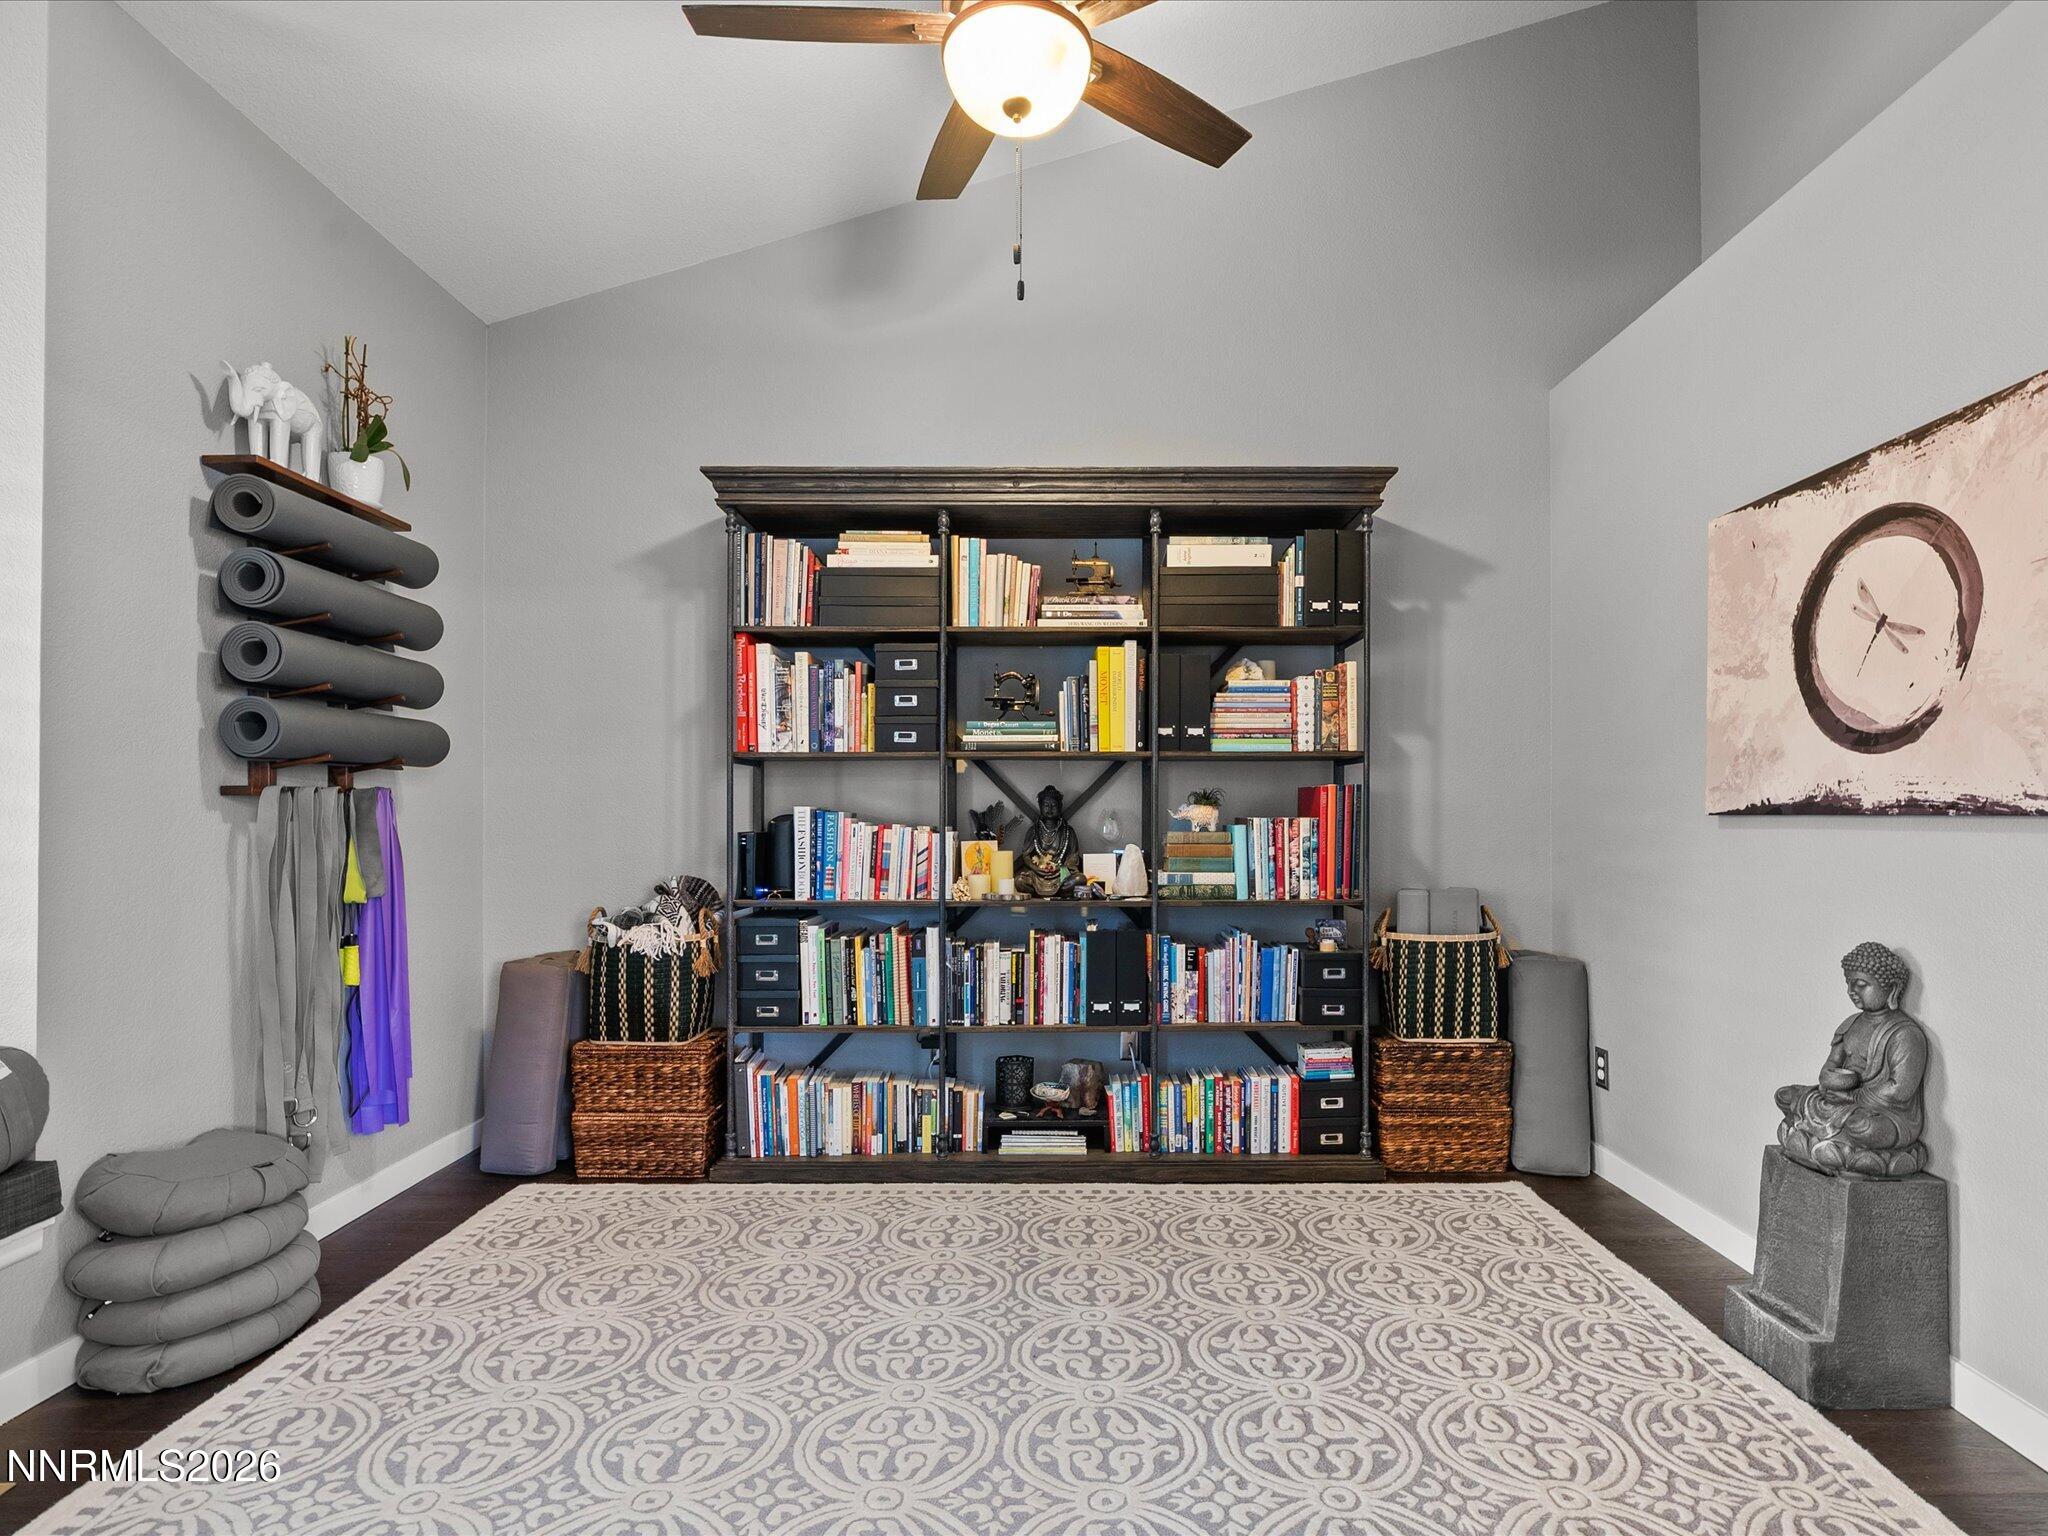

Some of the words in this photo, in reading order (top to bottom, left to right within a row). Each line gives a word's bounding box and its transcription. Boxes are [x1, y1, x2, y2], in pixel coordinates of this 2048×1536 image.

[736, 637, 746, 674] Norman
[736, 674, 746, 717] Rockwell
[826, 814, 835, 862] FASHION
